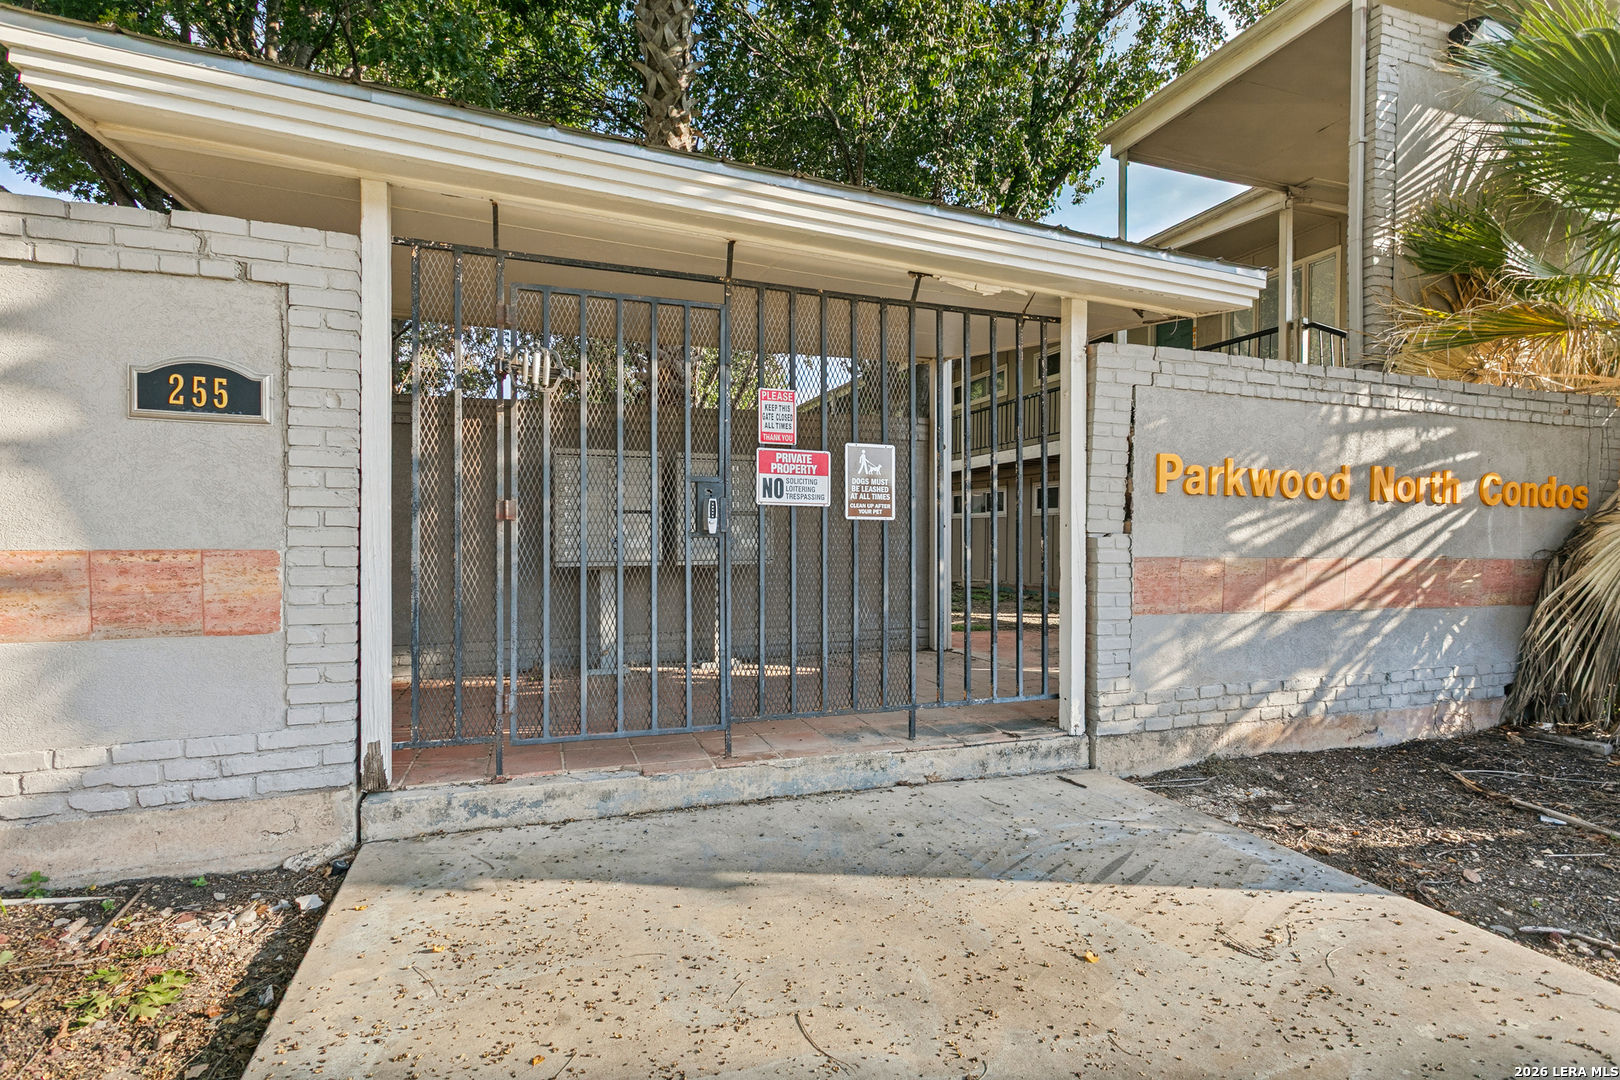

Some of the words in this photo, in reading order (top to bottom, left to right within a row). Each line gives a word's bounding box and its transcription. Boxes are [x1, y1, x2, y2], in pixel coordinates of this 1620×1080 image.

[168, 373, 229, 409] 255
[761, 391, 793, 402] PLEASE
[764, 403, 778, 412] KEEP
[762, 413, 774, 421] GATE
[776, 413, 793, 422] CLOSED
[776, 422, 793, 430] TIMES
[763, 433, 781, 441] THANK
[782, 434, 793, 442] YOU
[775, 452, 813, 464] PRIVATE
[770, 462, 818, 475] PROPERTY
[785, 477, 818, 486] SOLICITING
[851, 477, 870, 485] DOGS
[870, 478, 889, 486] MUST
[1156, 453, 1351, 501] Parkwood
[1370, 465, 1462, 504] North
[1479, 472, 1589, 510] Condos
[762, 477, 785, 499] NO
[785, 485, 816, 493] LOITERING
[861, 485, 889, 493] LEASHED
[785, 492, 825, 501] TRESPASSING
[850, 492, 859, 500] AT
[871, 493, 891, 501] TIMES
